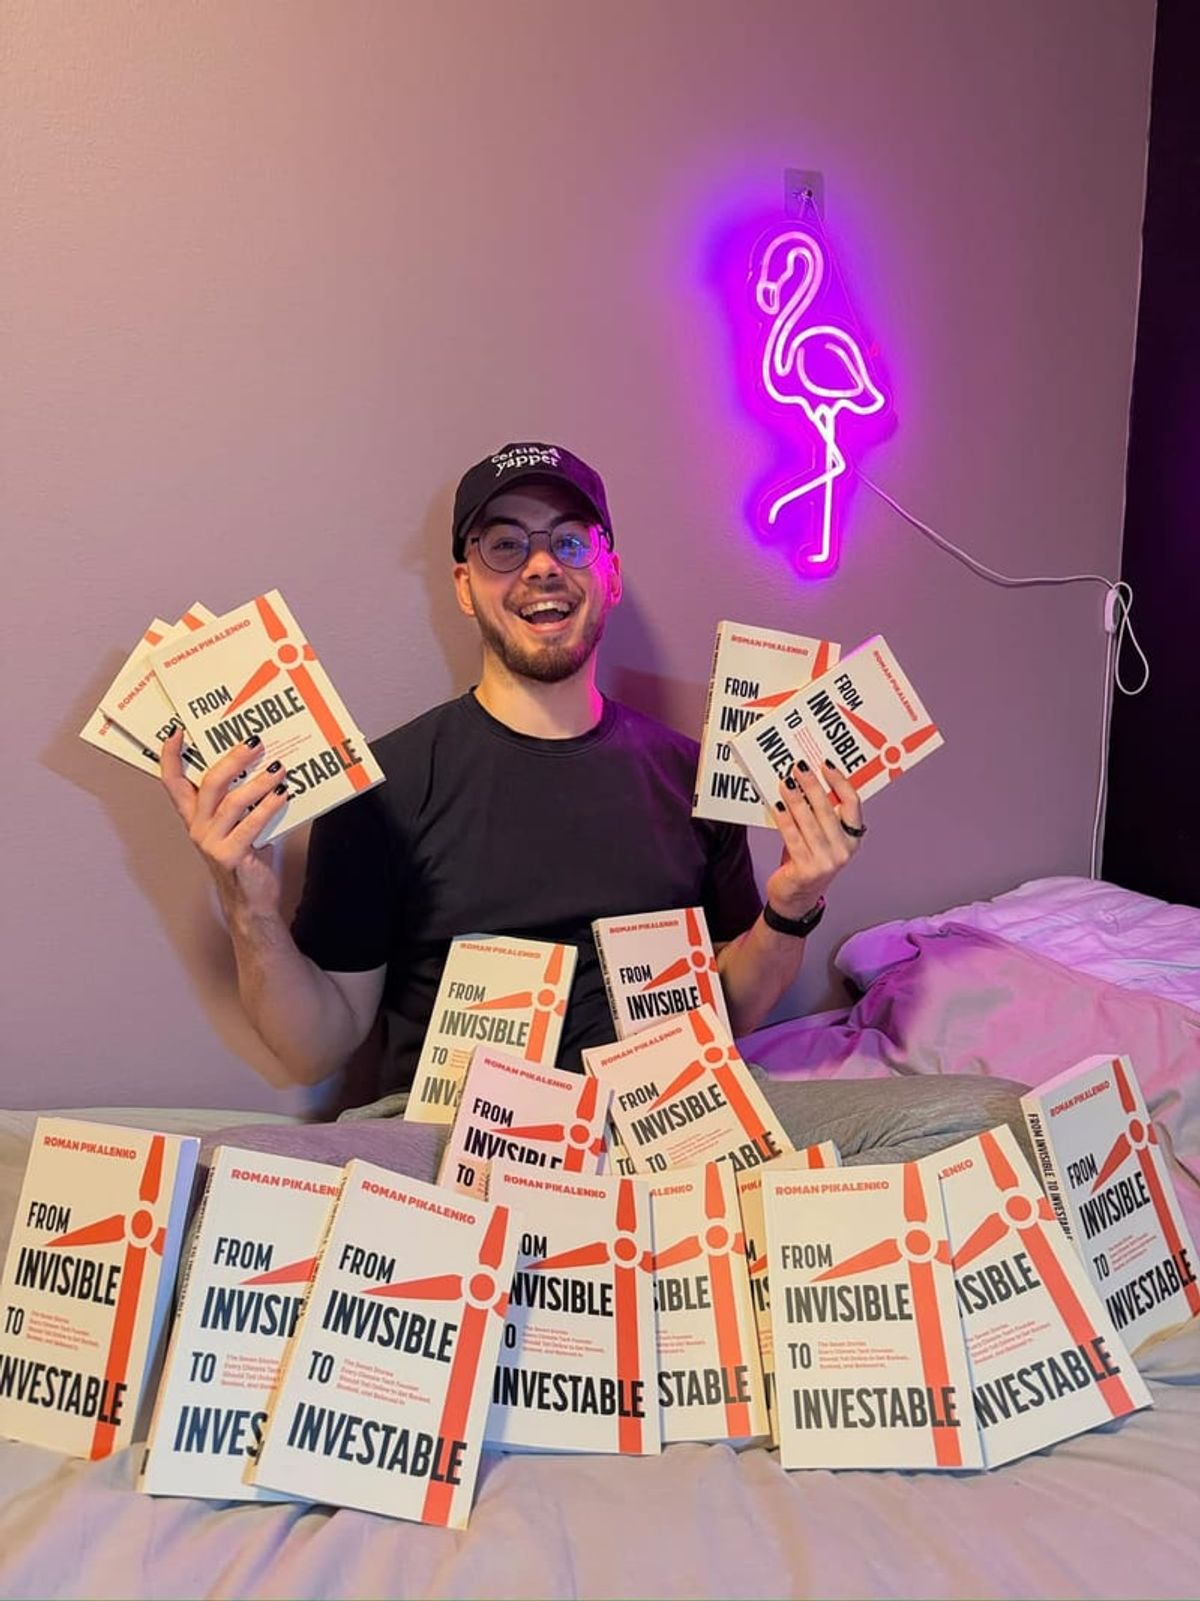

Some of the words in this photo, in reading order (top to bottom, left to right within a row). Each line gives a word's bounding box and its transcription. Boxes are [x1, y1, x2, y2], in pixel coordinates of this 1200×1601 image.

[496, 455, 559, 477] yapper
[163, 646, 199, 669] ROMAN
[199, 619, 251, 651] PIKALENKO
[188, 684, 234, 719] FROM
[724, 676, 760, 700] FROM
[834, 673, 864, 712] FROM
[205, 686, 306, 754] INVISIBLE
[784, 709, 802, 730] TO
[807, 690, 868, 774] INVISIBLE
[716, 743, 731, 761] TO
[286, 739, 363, 800] STABLE
[711, 772, 761, 803] INVES
[609, 923, 638, 935] ROMAN
[460, 942, 492, 953] ROMAN
[619, 964, 653, 985] FROM
[447, 981, 487, 1003] FROM
[626, 986, 702, 1021] INVISIBLE
[438, 1009, 530, 1048] INVISIBLE
[432, 1046, 449, 1065] TO
[600, 1048, 634, 1067] ROMAN
[634, 1027, 684, 1053] PIKALENKO
[484, 1057, 519, 1076] ROMAN
[519, 1068, 573, 1091] PIKALENKO
[472, 1097, 514, 1127] FROM
[618, 1082, 660, 1112] FROM
[1050, 1097, 1076, 1117] ROMAN
[630, 1084, 728, 1146] INVISIBLE
[44, 1135, 79, 1151] ROMAN
[80, 1141, 137, 1160] PIKALENKO
[645, 1153, 668, 1174] TO
[1028, 1113, 1044, 1137] FROM
[1047, 1180, 1059, 1191] TO
[231, 1168, 281, 1188] ROMAN
[282, 1178, 341, 1197] PIKALEN
[456, 1163, 475, 1187] TO
[616, 1157, 637, 1176] TO
[1067, 1153, 1099, 1189] FROM
[361, 1179, 407, 1204] ROMAN
[407, 1193, 477, 1225] PIKALENKO
[504, 1174, 543, 1190] ROMAN
[543, 1182, 607, 1199] PIKALENKO
[650, 1184, 693, 1197] ALENKO
[775, 1184, 820, 1196] ROMAN
[821, 1180, 890, 1194] PIKALENKO
[26, 1201, 71, 1234] FROM
[1078, 1172, 1151, 1240] INVISIBLE
[213, 1237, 274, 1272] FROM
[519, 1233, 548, 1258] OM
[781, 1243, 833, 1269] FROM
[15, 1247, 121, 1306] INVISIBLE
[338, 1244, 397, 1283] FROM
[1093, 1253, 1111, 1281] TO
[508, 1271, 614, 1317] NVISIBLE
[955, 1252, 1041, 1318] ISIBLE
[1106, 1248, 1198, 1332] INVESTABLE
[200, 1286, 305, 1338] INVISI
[785, 1283, 913, 1323] INVISIBLE
[5, 1306, 24, 1336] TO
[322, 1289, 458, 1363] INVISIBLE
[504, 1323, 517, 1349] O
[189, 1351, 217, 1383] TO
[307, 1350, 335, 1384] TO
[788, 1343, 812, 1369] TO
[492, 1365, 645, 1419] INVESTABLE
[657, 1365, 751, 1407] STABLE
[972, 1336, 1121, 1430] NVESTABLE
[793, 1386, 961, 1429] INVESTABLE
[173, 1406, 269, 1458] INVES
[286, 1402, 468, 1485] INVESTABLE
